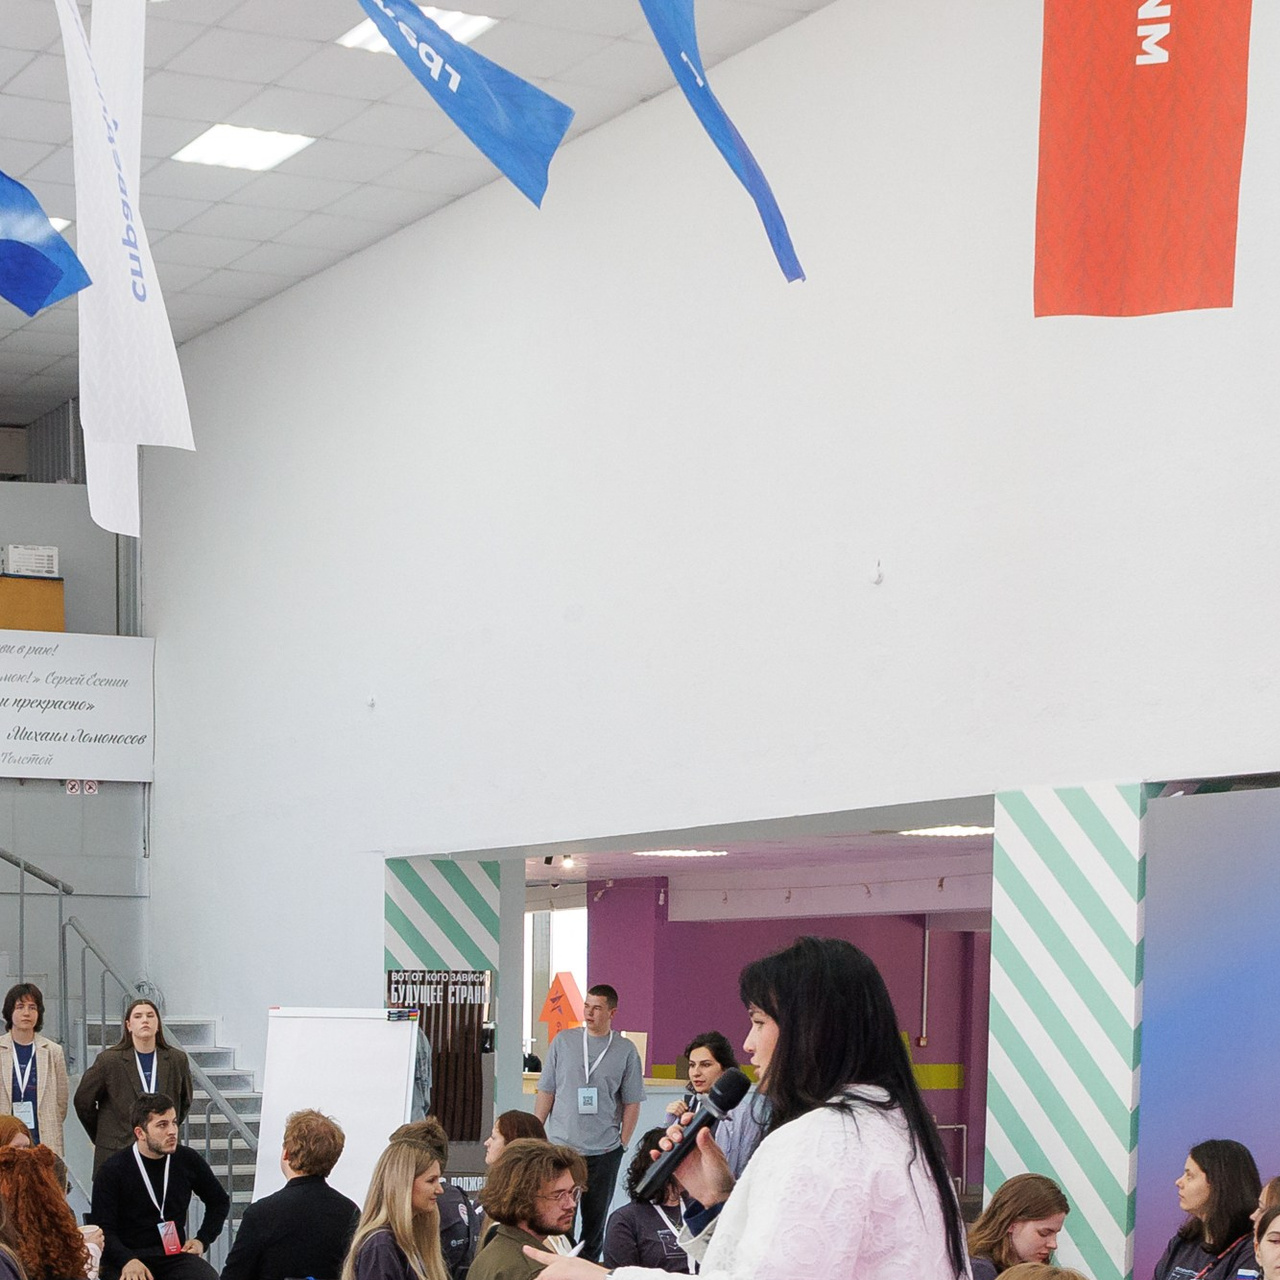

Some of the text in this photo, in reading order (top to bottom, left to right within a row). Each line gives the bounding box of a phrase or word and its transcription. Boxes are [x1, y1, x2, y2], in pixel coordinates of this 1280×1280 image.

[45, 671, 87, 688] Сергей
[86, 672, 129, 688] Есенин
[0, 697, 11, 708] и
[6, 725, 147, 746] Михаил Ломоносов
[1, 751, 55, 766] Толстой
[391, 972, 410, 981] ВОТ
[411, 972, 424, 982] ОТ
[425, 973, 449, 982] КОГО
[390, 984, 443, 1006] БУДУЩЕЕ
